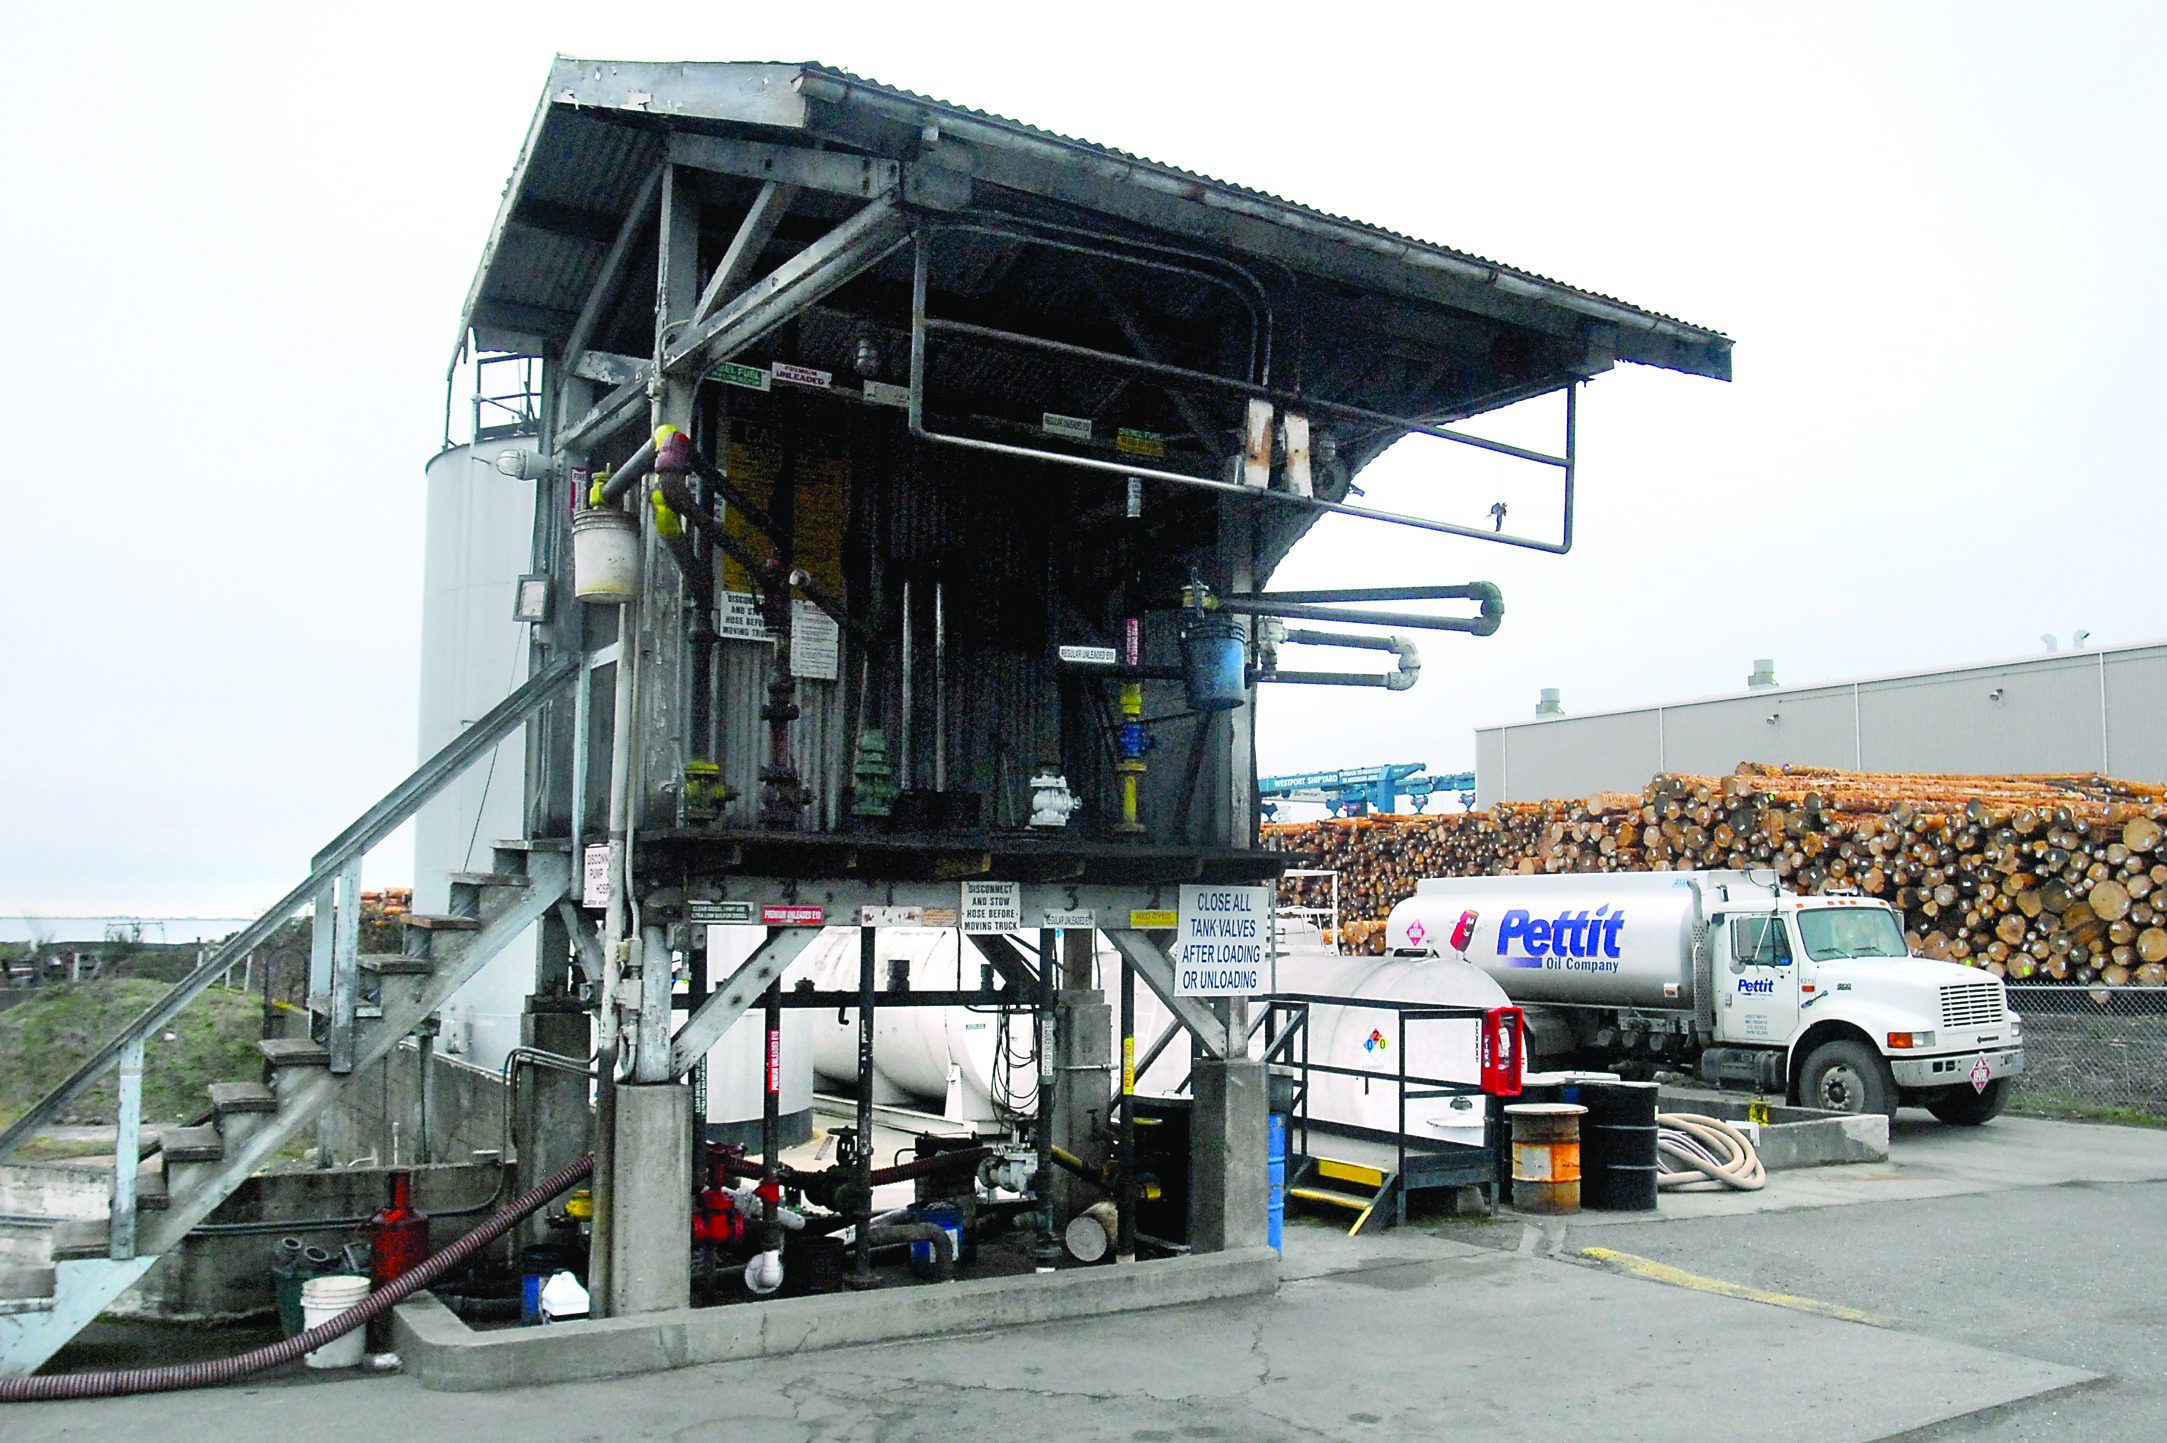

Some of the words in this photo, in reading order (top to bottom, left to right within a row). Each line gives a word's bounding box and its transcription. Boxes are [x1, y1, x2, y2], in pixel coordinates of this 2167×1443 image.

[737, 368, 760, 380] FUEL
[785, 364, 818, 376] PREMIUM
[776, 371, 825, 386] UNLEADED
[730, 606, 746, 615] AND
[726, 616, 744, 625] HOSE
[746, 617, 764, 627] BEFO
[723, 626, 750, 637] MOVING
[1061, 648, 1081, 658] REGULAR
[1082, 650, 1105, 660] UNLEADED
[1274, 777, 1306, 788] WESTPORT
[1307, 774, 1338, 785] SHIPYARD
[590, 868, 604, 879] PUMP
[968, 884, 1013, 894] DISCONNECT
[972, 897, 988, 906] AND
[990, 897, 1010, 906] STOW
[1063, 885, 1079, 911] 3
[1197, 893, 1231, 912] CLOSE
[1233, 893, 1252, 912] ALL
[764, 910, 786, 919] PREMIUM
[787, 911, 811, 920] UNLEADED
[812, 911, 822, 920] E10
[966, 909, 986, 918] HOSE
[988, 909, 1015, 918] BEFORE
[1136, 912, 1151, 920] RED
[1152, 912, 1172, 920] DYED
[964, 921, 992, 930] MOVING
[995, 921, 1018, 930] TRUCK
[1191, 919, 1217, 937] TANK
[1219, 919, 1256, 938] VALVES
[1496, 903, 1626, 958] Pettit
[1182, 944, 1215, 963] AFTER
[1217, 945, 1260, 964] LOADING
[1546, 957, 1562, 971] Oil
[1566, 957, 1619, 974] Company
[1183, 971, 1198, 989] OR
[1200, 970, 1257, 989] UNLOADING
[1737, 977, 1775, 993] Pettit
[1373, 1030, 1380, 1042] 2
[1367, 1039, 1373, 1050] 0
[1379, 1038, 1386, 1050] 0
[771, 1041, 779, 1067] UNLEADED
[771, 1068, 779, 1091] PREMIUM
